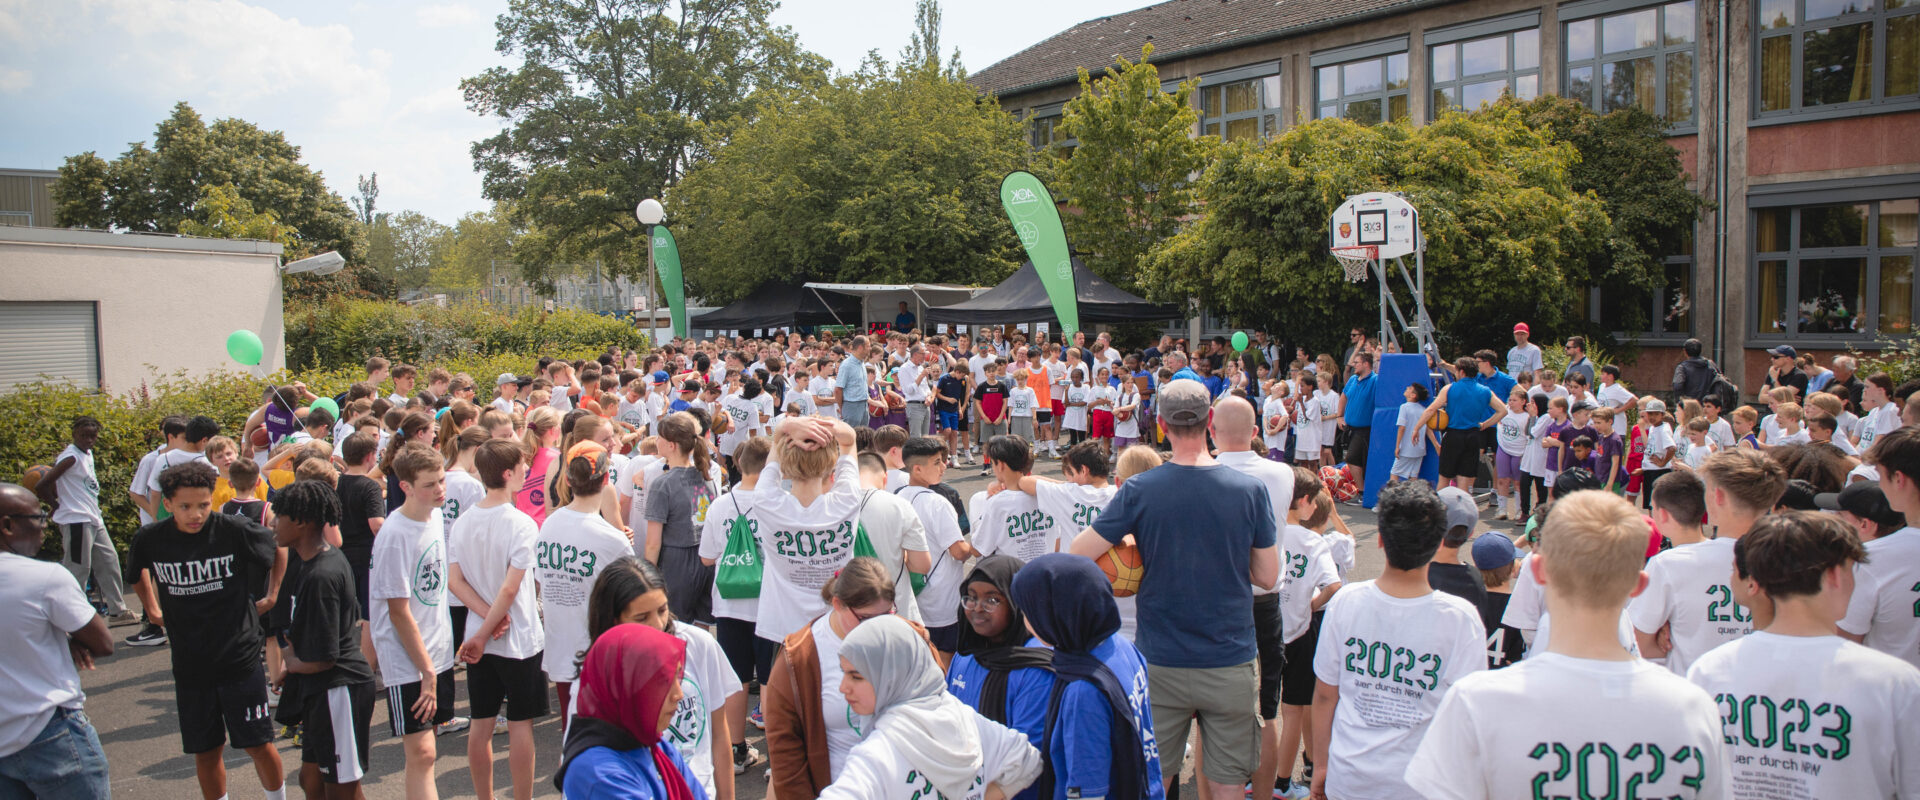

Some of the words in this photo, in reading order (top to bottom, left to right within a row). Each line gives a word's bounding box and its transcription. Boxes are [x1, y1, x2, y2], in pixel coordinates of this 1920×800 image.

[1349, 204, 1355, 216] 1
[1363, 222, 1382, 232] 3X3
[774, 520, 854, 557] 2023
[153, 554, 234, 586] NOLIMIT
[537, 541, 596, 577] 2023
[722, 553, 745, 566] AOK
[168, 581, 224, 596] TALENTSCHMIEDE
[1344, 636, 1442, 691] 2023
[1375, 682, 1402, 696] durch
[1404, 688, 1424, 700] NRW
[1714, 692, 1852, 761] 2023
[1528, 742, 1705, 800] 2023
[1759, 754, 1799, 772] durch
